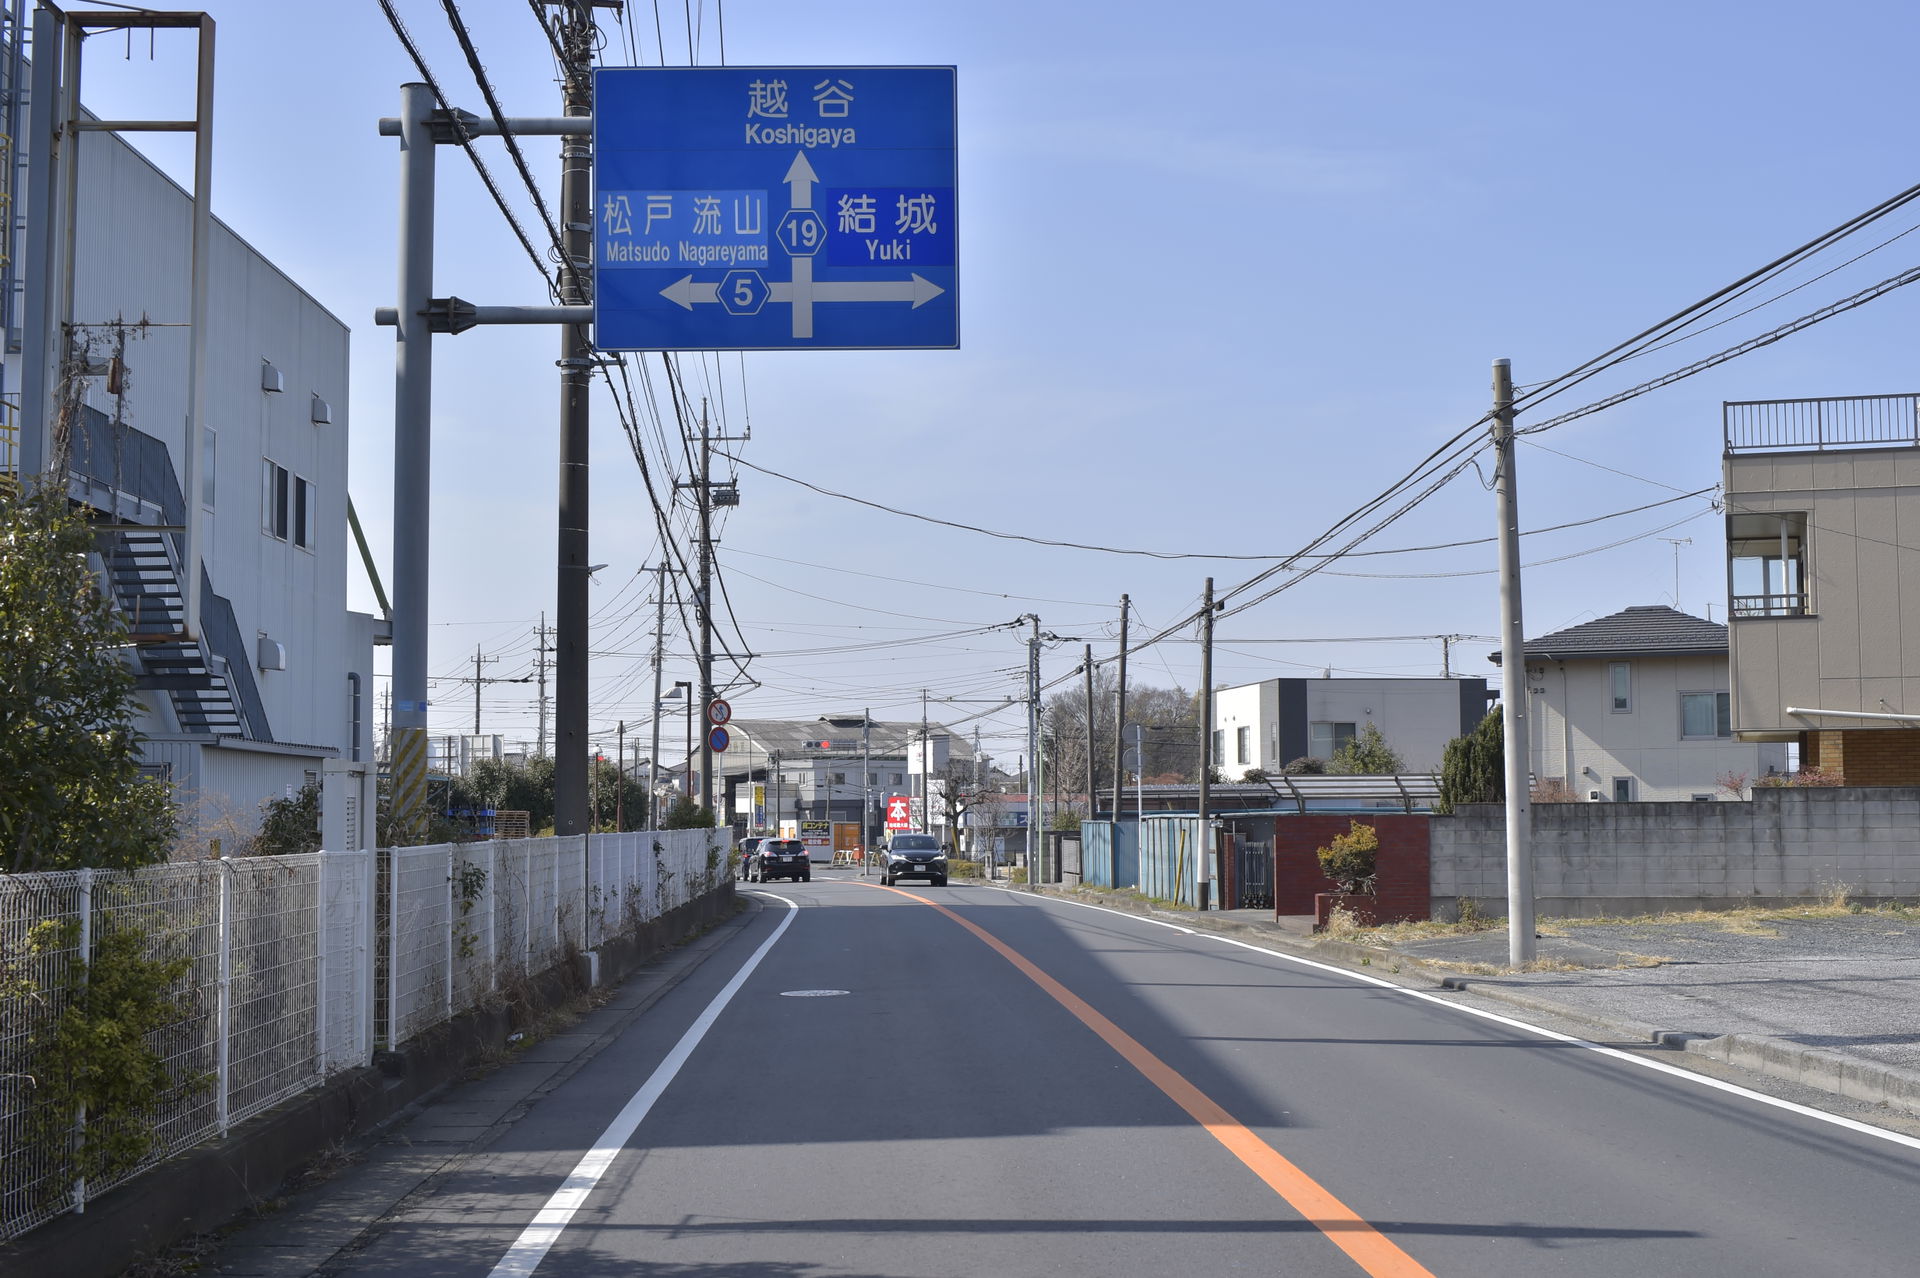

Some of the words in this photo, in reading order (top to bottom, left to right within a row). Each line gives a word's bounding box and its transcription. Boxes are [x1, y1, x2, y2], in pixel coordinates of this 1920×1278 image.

[747, 79, 854, 118] 越谷
[745, 124, 856, 148] Koshigaya
[603, 195, 672, 236] 松戸
[693, 195, 761, 235] 流山
[837, 194, 937, 234] 結城
[787, 220, 818, 247] 19
[606, 241, 670, 262] Matsudo
[679, 241, 768, 266] Nagareyama
[865, 239, 911, 260] Yuki
[734, 280, 753, 306] 5
[890, 800, 907, 821] 本
